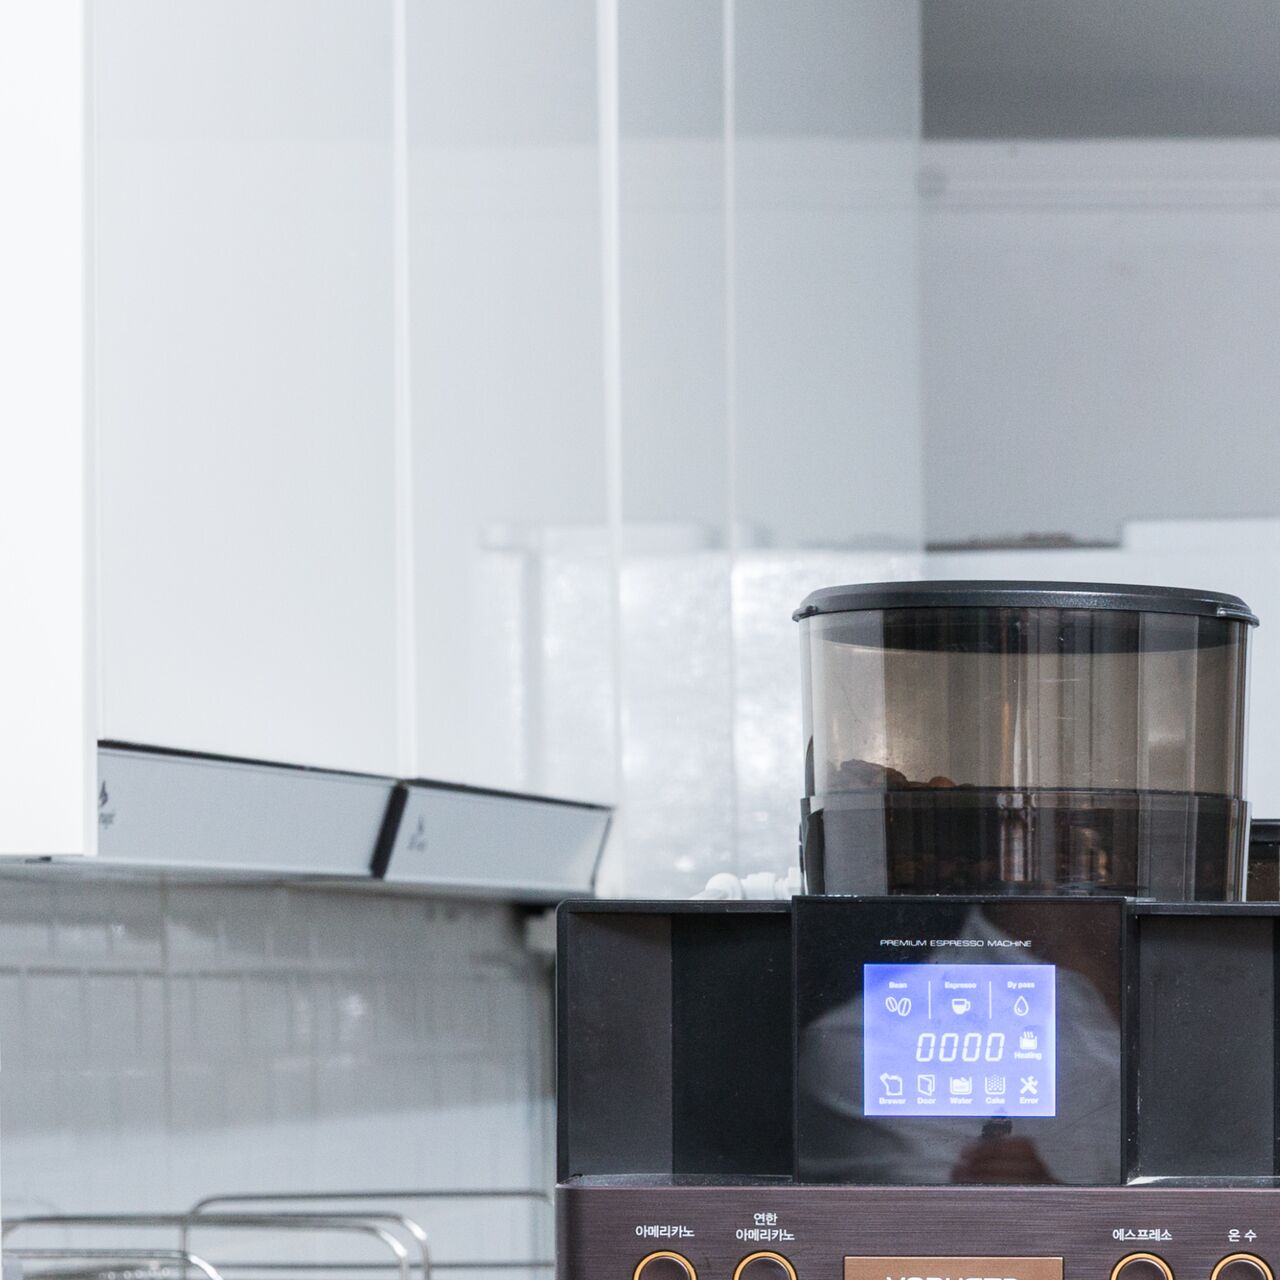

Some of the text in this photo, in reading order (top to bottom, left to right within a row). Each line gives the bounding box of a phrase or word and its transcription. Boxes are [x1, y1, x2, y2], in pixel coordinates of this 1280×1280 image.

[880, 939, 927, 947] PREMIUM
[930, 939, 984, 947] ESPRESSO
[915, 1032, 1005, 1062] 0000
[950, 1097, 973, 1105] Water
[1019, 1097, 1039, 1105] Error
[753, 1212, 778, 1226] 연한
[635, 1225, 695, 1238] 아메리카노
[735, 1229, 795, 1242] 아메리카노
[1112, 1228, 1173, 1242] 에스프레소
